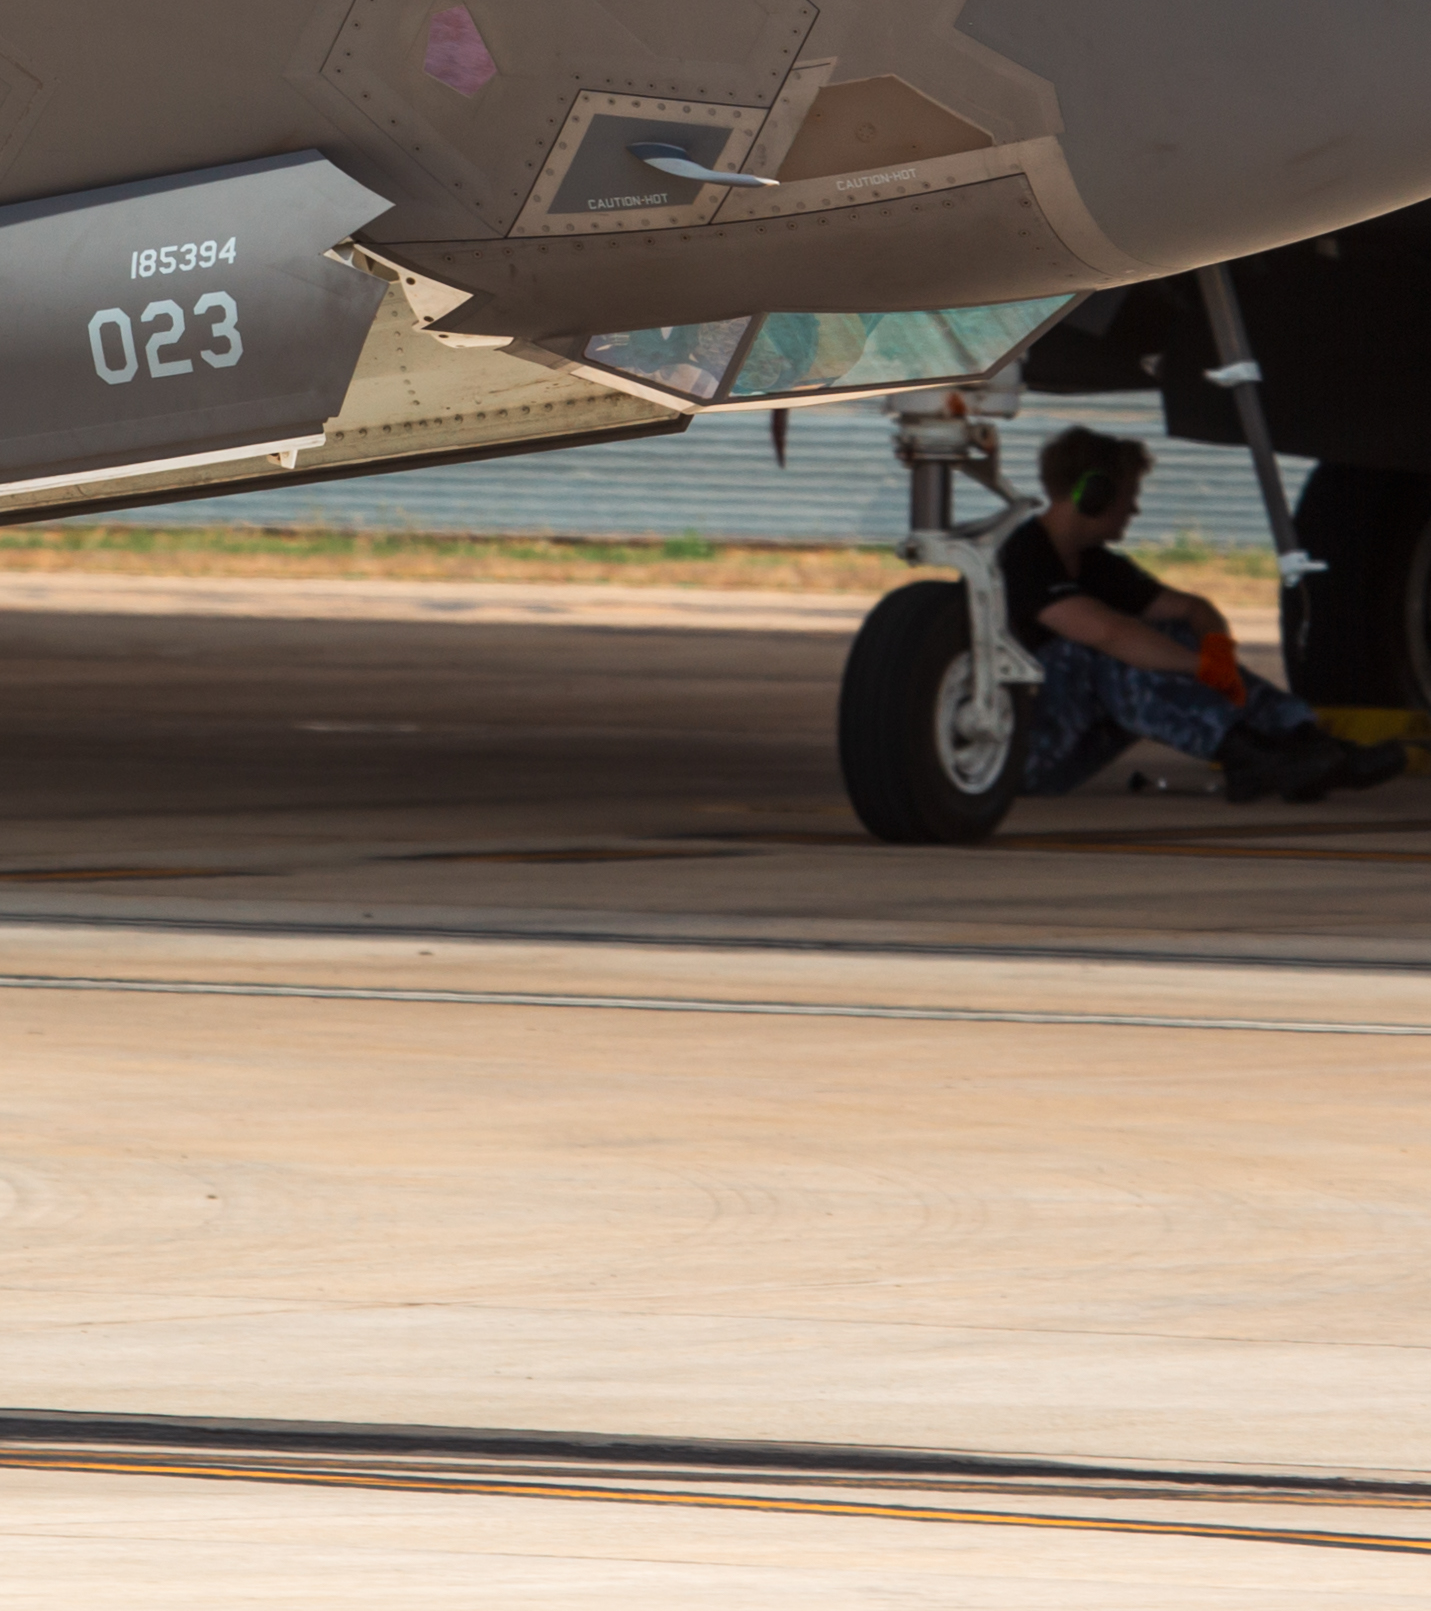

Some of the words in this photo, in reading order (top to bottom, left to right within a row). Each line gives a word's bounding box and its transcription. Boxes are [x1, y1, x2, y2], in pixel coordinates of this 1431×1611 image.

[835, 167, 917, 191] CAUTION-HOT
[587, 193, 669, 210] CAUTION-HOT
[131, 236, 237, 279] 185394
[87, 290, 243, 385] 023
